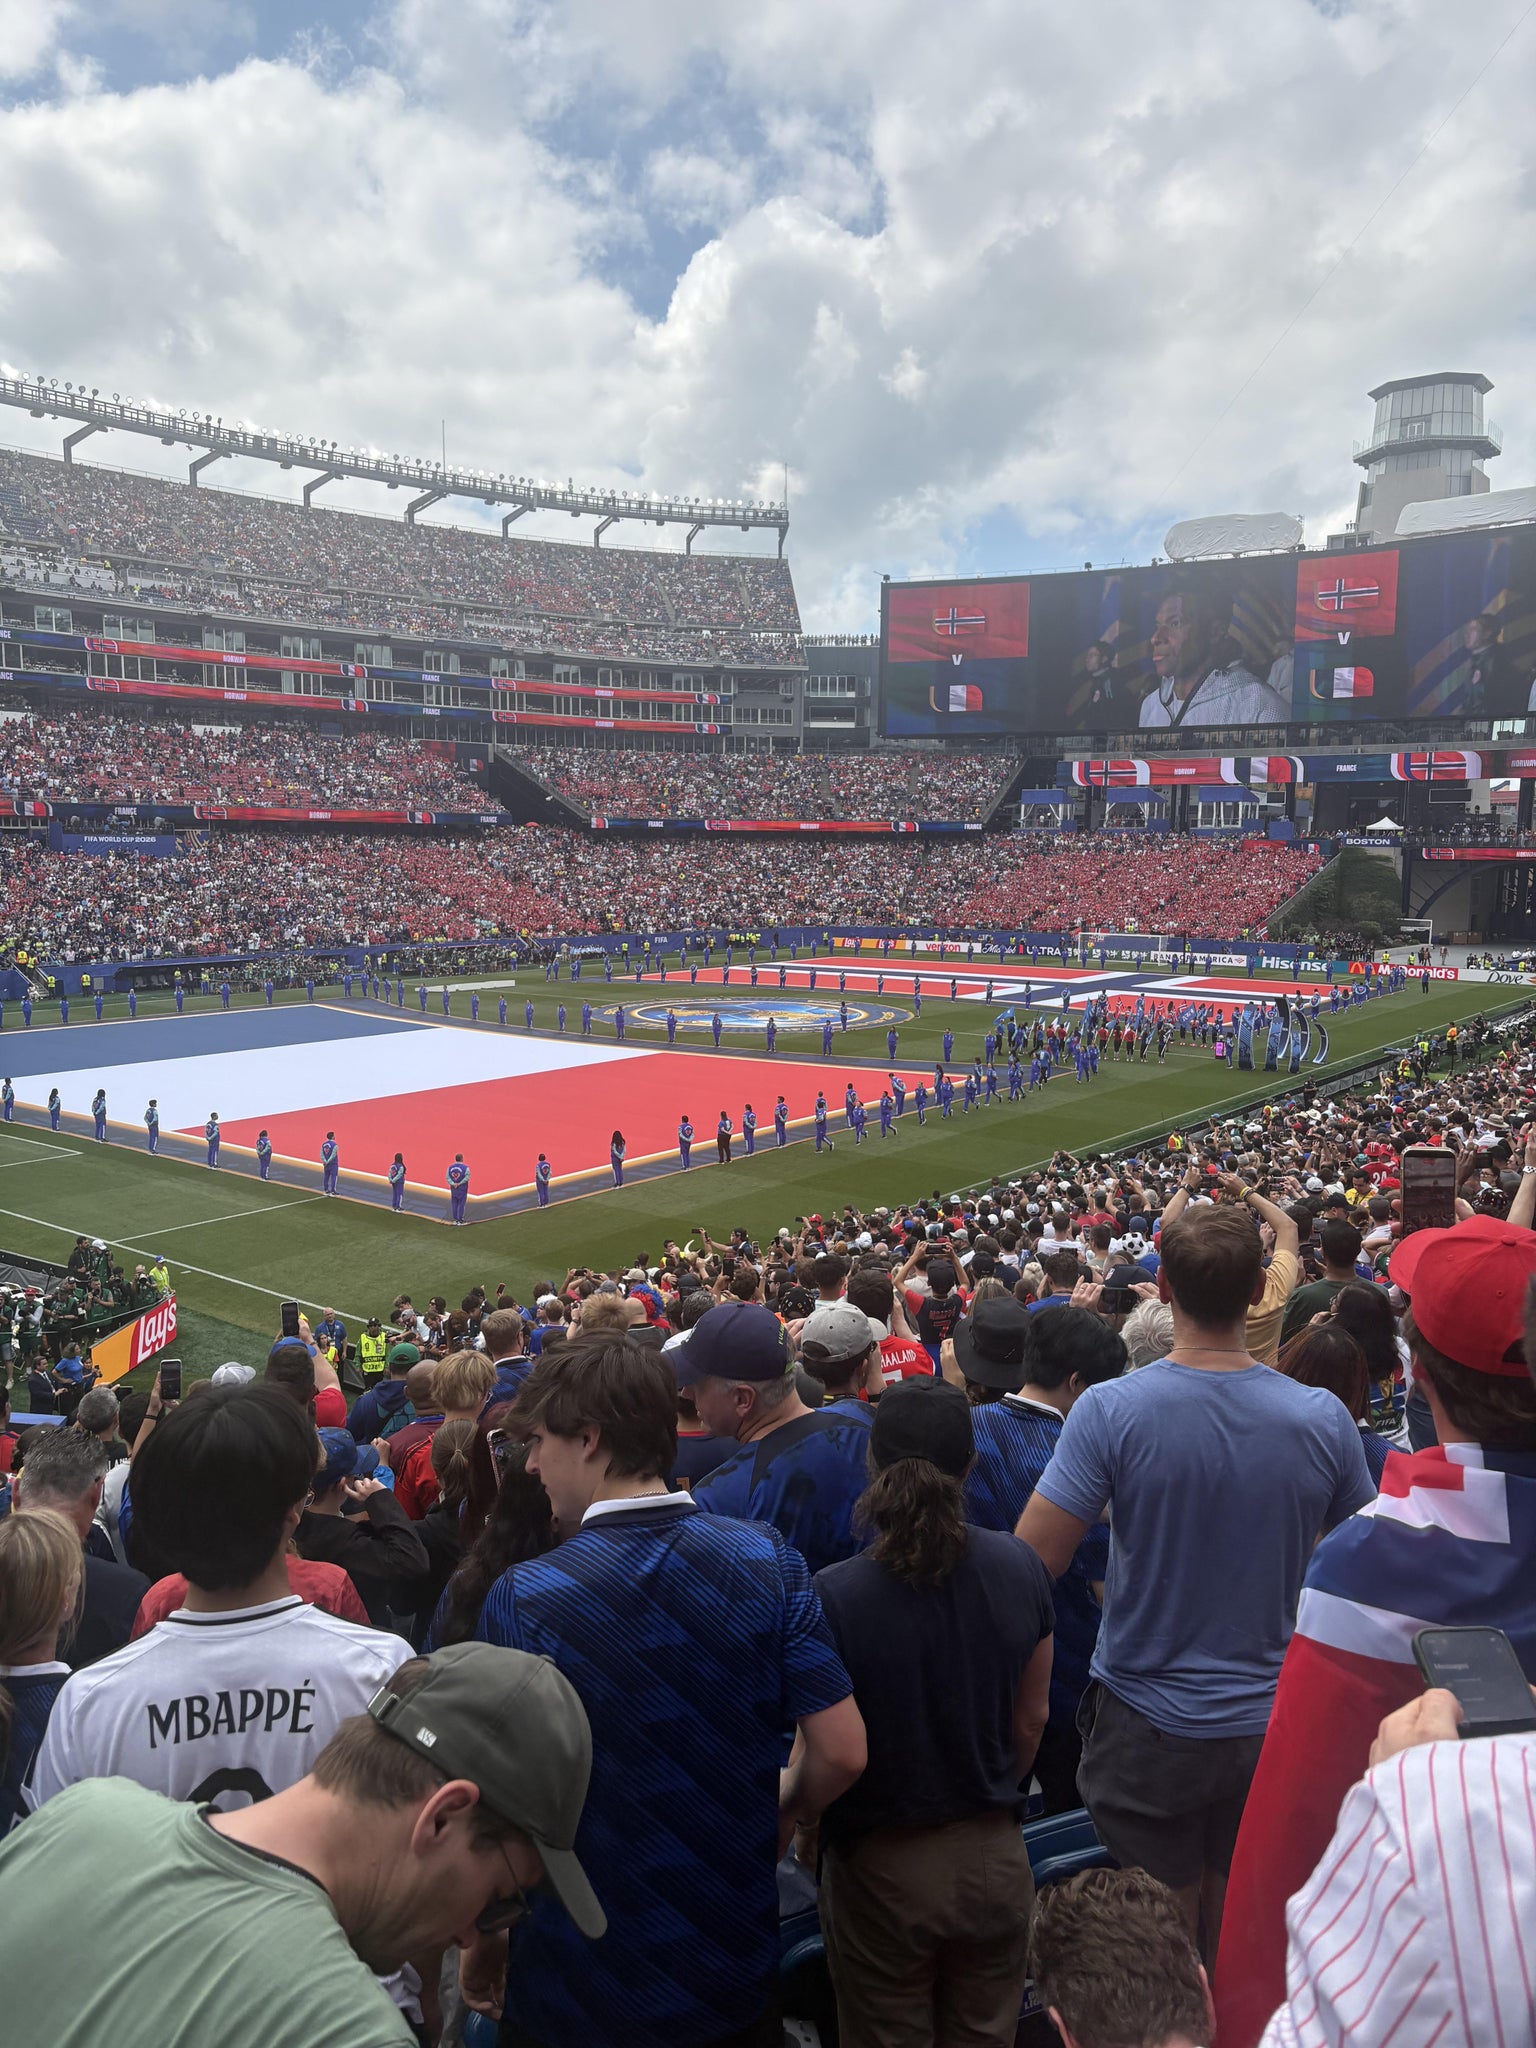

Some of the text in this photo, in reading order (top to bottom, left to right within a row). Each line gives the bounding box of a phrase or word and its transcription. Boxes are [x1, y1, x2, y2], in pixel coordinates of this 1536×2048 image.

[223, 655, 246, 664] NORWAY
[422, 674, 440, 682] FRANCE
[224, 692, 247, 700] NORWAY
[422, 707, 441, 716] FRANCE
[1336, 764, 1357, 772] FRANCE
[115, 807, 137, 815] FRANCE
[654, 936, 668, 944] FIFA
[925, 942, 961, 952] verzon
[1026, 946, 1061, 955] UTRA
[1487, 970, 1524, 985] Dove
[137, 1298, 177, 1364] Lay's
[1376, 1418, 1396, 1427] FIFA
[147, 1678, 316, 1749] MBAPPÉ
